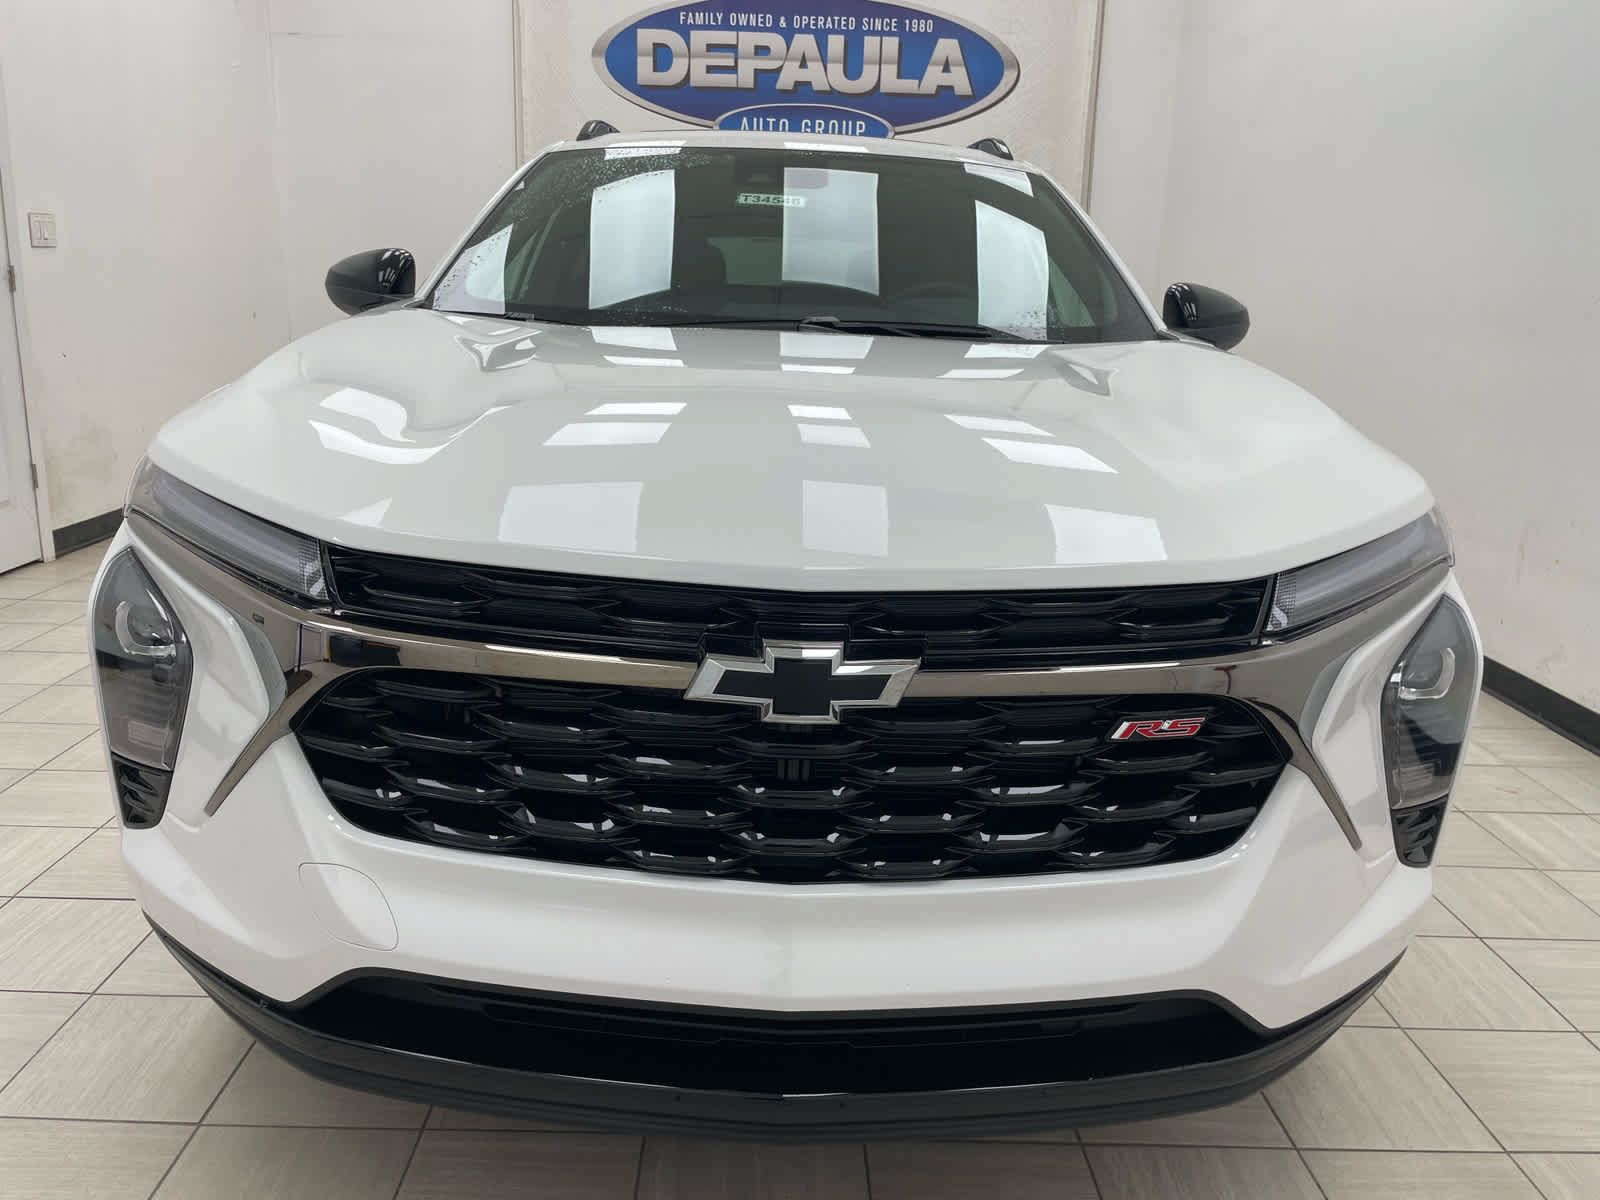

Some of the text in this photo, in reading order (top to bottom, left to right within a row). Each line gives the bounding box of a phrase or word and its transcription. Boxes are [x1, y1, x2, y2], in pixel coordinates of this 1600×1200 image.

[679, 11, 934, 33] FAMILY OWNED & OPERATED SINCE 1980
[636, 28, 973, 97] DEPAULA
[740, 116, 866, 136] AUTO GROUP
[1111, 717, 1206, 740] RS
